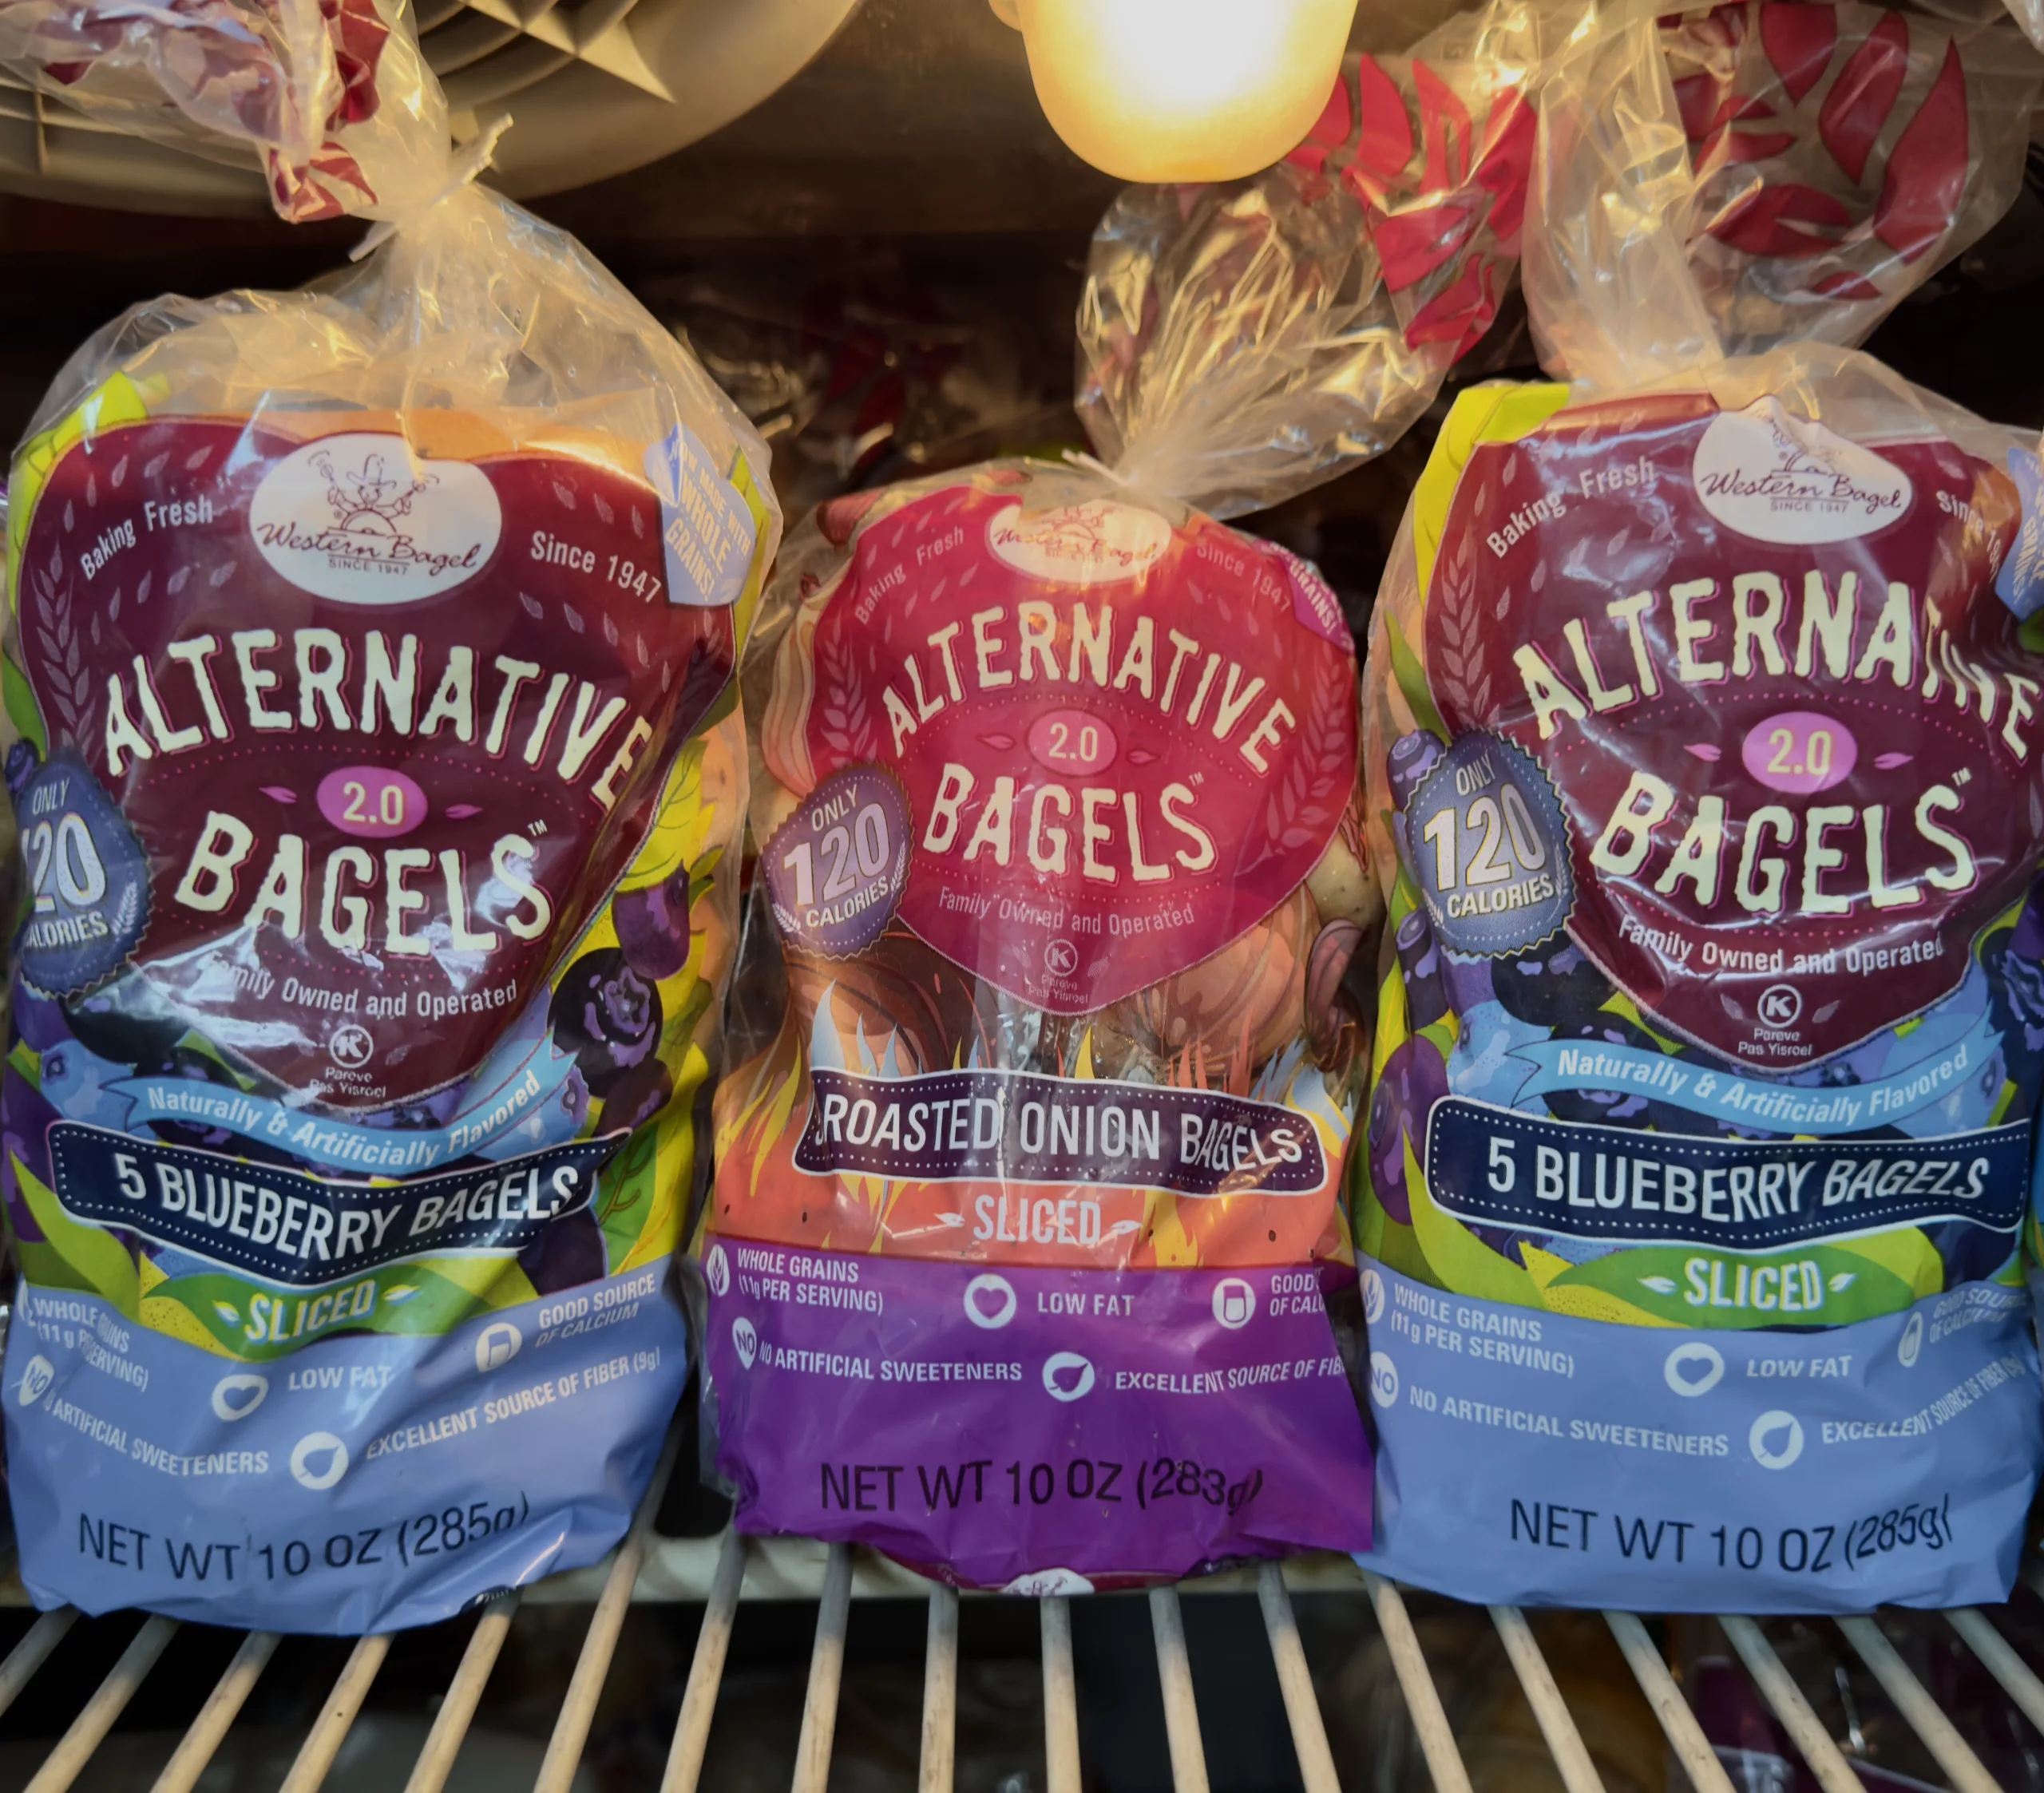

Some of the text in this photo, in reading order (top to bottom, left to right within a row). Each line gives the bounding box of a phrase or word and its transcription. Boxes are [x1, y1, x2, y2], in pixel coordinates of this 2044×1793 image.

[699, 466, 728, 519] MADE
[727, 510, 751, 557] WITH
[1486, 455, 1655, 559] Baking Fresh
[1700, 469, 1902, 515] Western Bagel
[1770, 501, 1848, 514] SINCE 1947
[79, 495, 213, 581] Baking Fresh
[256, 521, 481, 576] Western Bagel
[681, 473, 731, 574] WHOLE
[328, 559, 409, 576] SINCE 1947
[530, 532, 661, 604] Since 1947
[665, 517, 715, 602] GRAINS!
[854, 526, 965, 624] Baking Fresh
[1197, 543, 1245, 576] Since
[1253, 567, 1290, 612] 1947
[882, 600, 1295, 772] ALTERNATIVE
[107, 628, 653, 812] ALTERNATIVE
[1049, 722, 1098, 762] 2.0
[1456, 750, 1495, 796] ONLY
[1768, 730, 1832, 775] 2.0
[32, 777, 70, 816] ONLY
[343, 782, 405, 824] 2.0
[811, 784, 858, 832] ONLY
[924, 762, 1216, 881] BAGELS
[783, 802, 893, 906] 120
[1424, 783, 1546, 893] 120
[1590, 770, 1975, 914] BAGELS
[175, 809, 553, 956] BAGELS
[806, 877, 889, 928] CALORIES
[1447, 873, 1555, 919] CALORIES
[25, 910, 109, 948] ALORIES
[939, 886, 1195, 938] Family Owned and Operated
[1618, 914, 1943, 976] Family Owned and Operated
[282, 977, 358, 1013] Owned
[366, 992, 407, 1016] and
[417, 979, 517, 1020] Operated
[1737, 1041, 1763, 1055] Pas
[1557, 1045, 1968, 1126] Naturally & Artificially Flavored
[148, 1069, 541, 1167] Naturally & Artificially Flavored
[823, 1094, 1303, 1172] ROASTED ONION BAGELS
[117, 1152, 579, 1260] 5 BLUEBERRY BAGELS
[1487, 1137, 1991, 1223] 5 BLUEBERRY BAGELS
[974, 1194, 1102, 1245] SLICED
[738, 1248, 859, 1283] WHOLE GRAINS
[1271, 1274, 1314, 1293] GOOD
[1683, 1257, 1821, 1310] SLICED
[34, 1297, 97, 1328] WHOLE
[245, 1279, 376, 1343] SLICED
[538, 1273, 656, 1330] GOOD SOURCE
[763, 1278, 790, 1301] PER
[796, 1284, 883, 1316] SERVING)
[1038, 1292, 1135, 1316] LOW FAT
[1270, 1297, 1288, 1316] OF
[1394, 1283, 1542, 1342] WHOLE GRAINS
[535, 1302, 640, 1348] OF CALCIUM
[736, 1331, 756, 1356] NO
[1425, 1326, 1462, 1353] PER
[1468, 1336, 1575, 1379] SERVING)
[27, 1363, 49, 1395] NO
[289, 1365, 394, 1391] LOW FAT
[759, 1340, 1022, 1382] NO ARTIFICIAL SWEETENERS
[1115, 1370, 1225, 1394] EXCELLENT
[1228, 1361, 1289, 1388] SOURCE
[1294, 1359, 1314, 1379] OF
[1746, 1356, 1852, 1379] LOW FAT
[366, 1408, 478, 1461] EXCELLENT
[483, 1382, 557, 1424] SOURCE
[559, 1374, 579, 1399] OF
[584, 1354, 629, 1390] FIBER
[1409, 1385, 1730, 1457] NO ARTIFICIAL SWEETENERS
[1821, 1408, 1932, 1445] EXCELLENT
[1930, 1386, 1973, 1425] SOURCE
[52, 1398, 128, 1455] ARTIFICIAL
[131, 1439, 270, 1477] SWEETENERS
[821, 1456, 1263, 1516] NET WT 10 OZ (283g)
[79, 1512, 151, 1571] NET
[165, 1538, 240, 1581] WT
[258, 1542, 311, 1580] 10
[324, 1530, 382, 1568] OZ
[1511, 1498, 1598, 1551] NET
[1614, 1514, 1695, 1563] WT
[1711, 1525, 1764, 1569] 10
[1778, 1525, 1836, 1573] OZ
